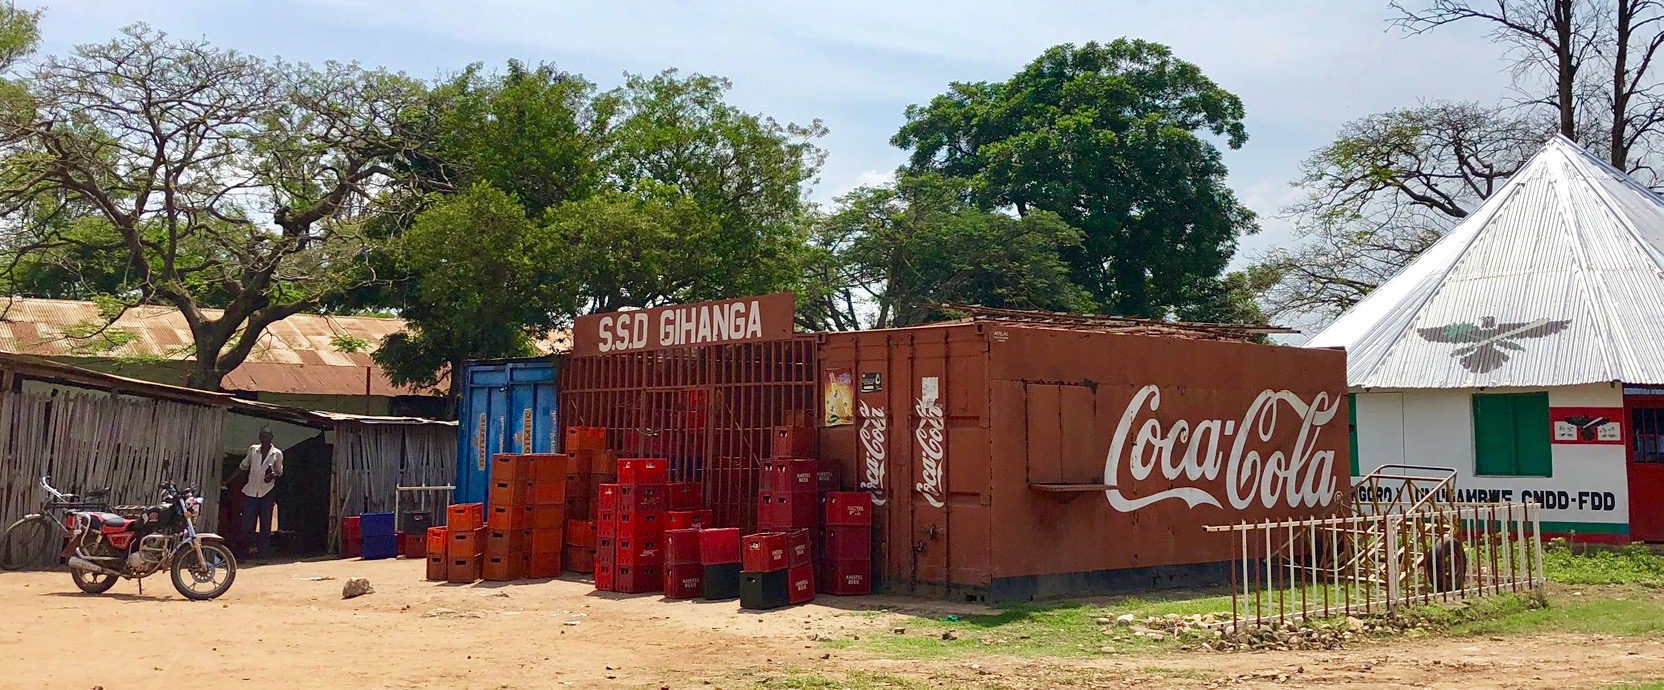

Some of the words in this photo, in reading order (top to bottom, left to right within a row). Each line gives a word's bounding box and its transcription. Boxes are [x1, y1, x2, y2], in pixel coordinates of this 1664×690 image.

[599, 313, 649, 352] S.S.D
[660, 301, 762, 346] GIHANGA
[859, 399, 887, 506] Coca-Cola
[915, 397, 945, 508] Coca-Cola
[1104, 384, 1342, 513] Coca-Cola
[1521, 490, 1616, 511] CNDD-FDD
